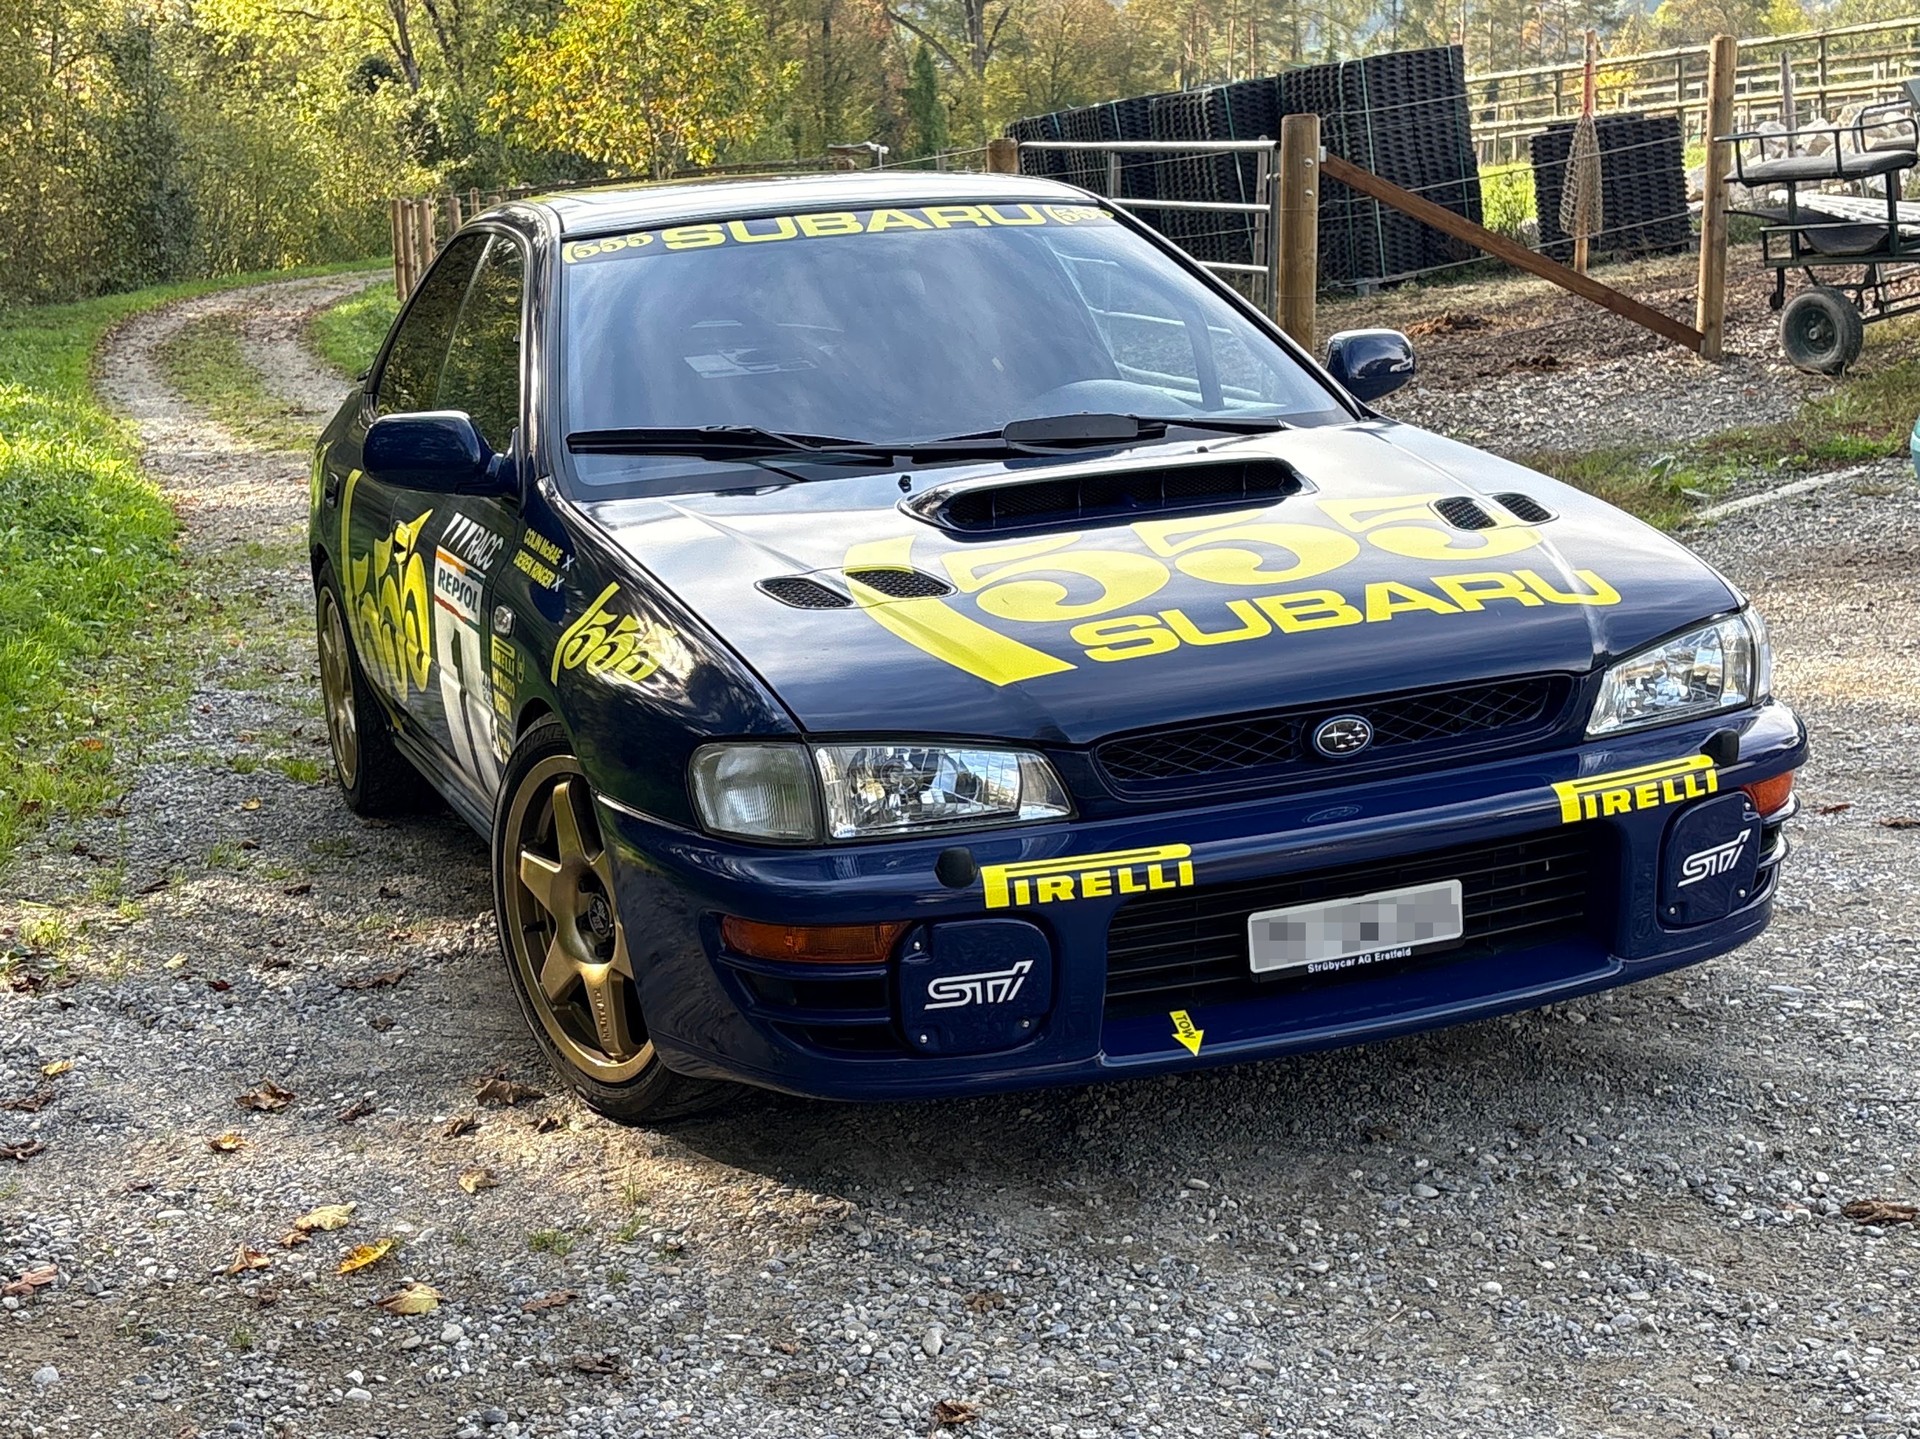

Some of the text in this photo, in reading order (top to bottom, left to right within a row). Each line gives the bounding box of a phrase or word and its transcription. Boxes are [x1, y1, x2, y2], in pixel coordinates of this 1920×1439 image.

[661, 204, 1047, 249] SUBARU
[941, 493, 1543, 622] 555
[437, 566, 478, 613] REPSOL
[1069, 567, 1623, 663] SUBARU
[1551, 754, 1718, 824] PIRELLI
[980, 843, 1194, 909] PIRELLI
[1307, 957, 1356, 973] Strübycar
[1357, 954, 1372, 965] AG
[1175, 1014, 1197, 1039] TOW
